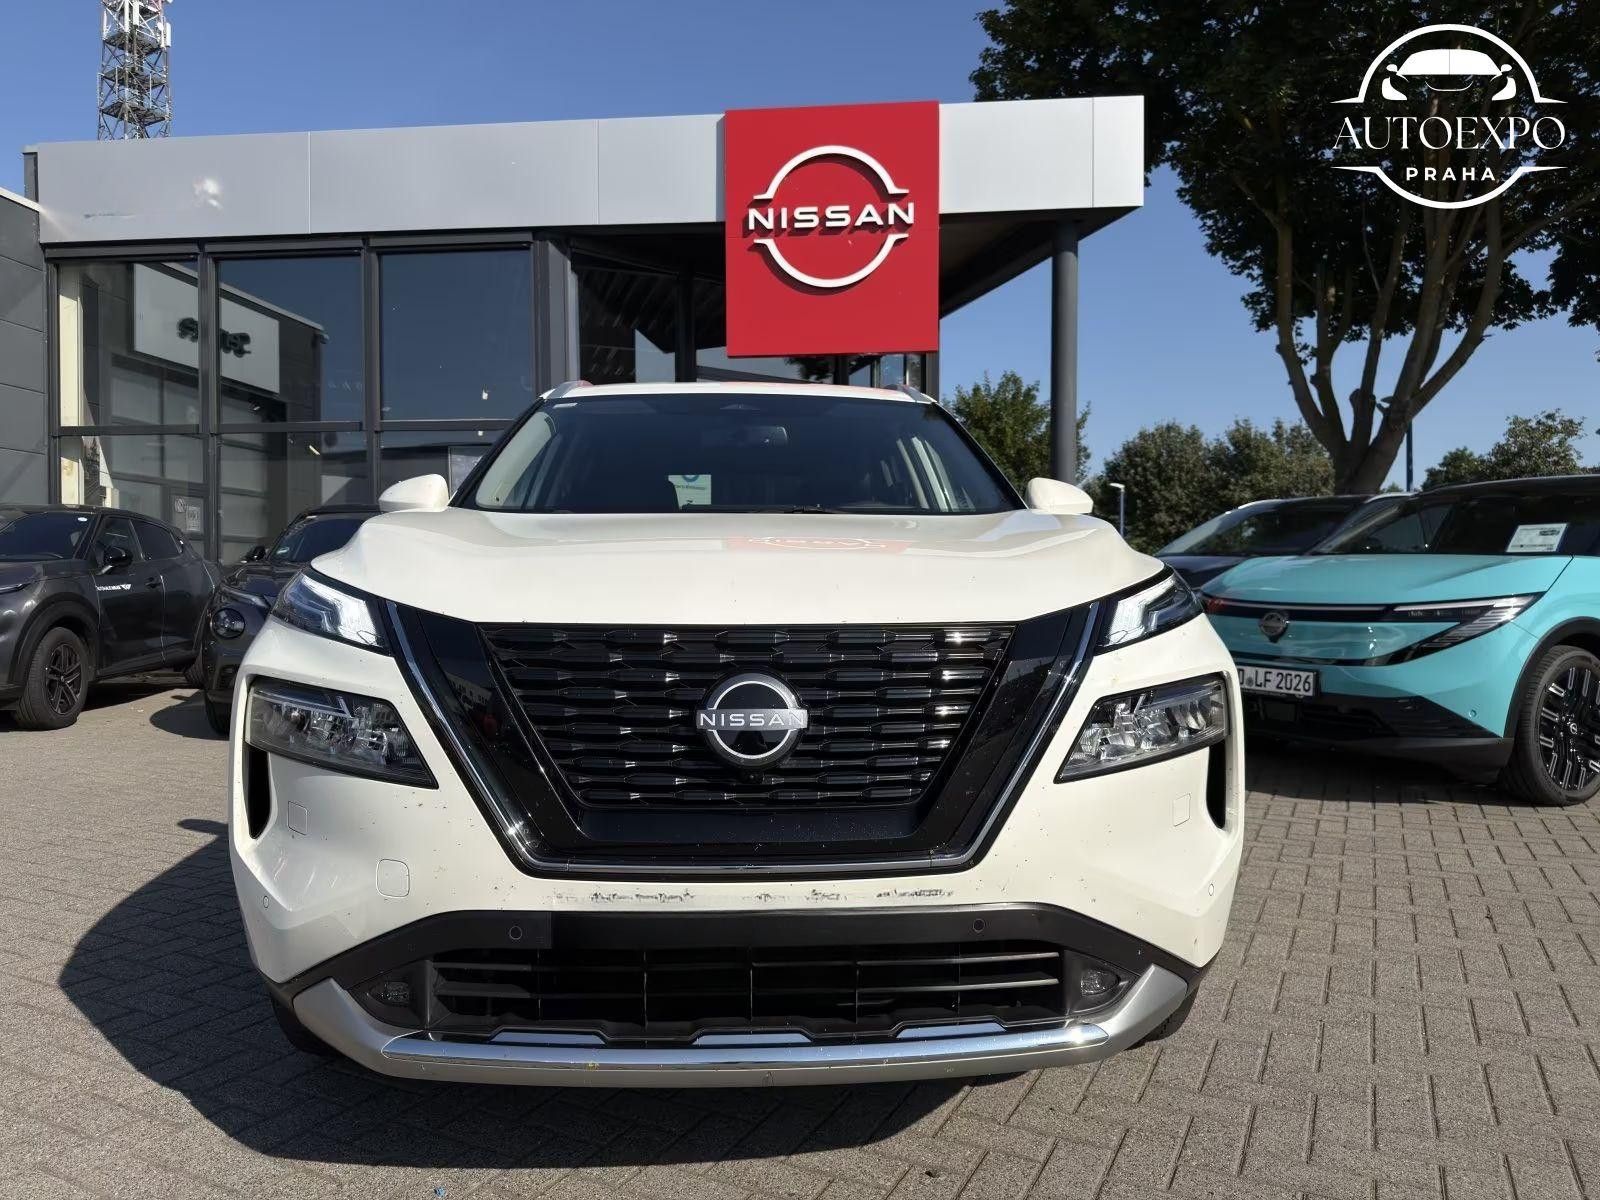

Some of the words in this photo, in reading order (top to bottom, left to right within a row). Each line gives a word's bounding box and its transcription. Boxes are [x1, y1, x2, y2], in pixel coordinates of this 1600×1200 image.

[748, 202, 915, 230] NISSAN
[1255, 670, 1272, 688] LF
[1276, 672, 1311, 692] 2026
[700, 713, 804, 727] NISSAN
